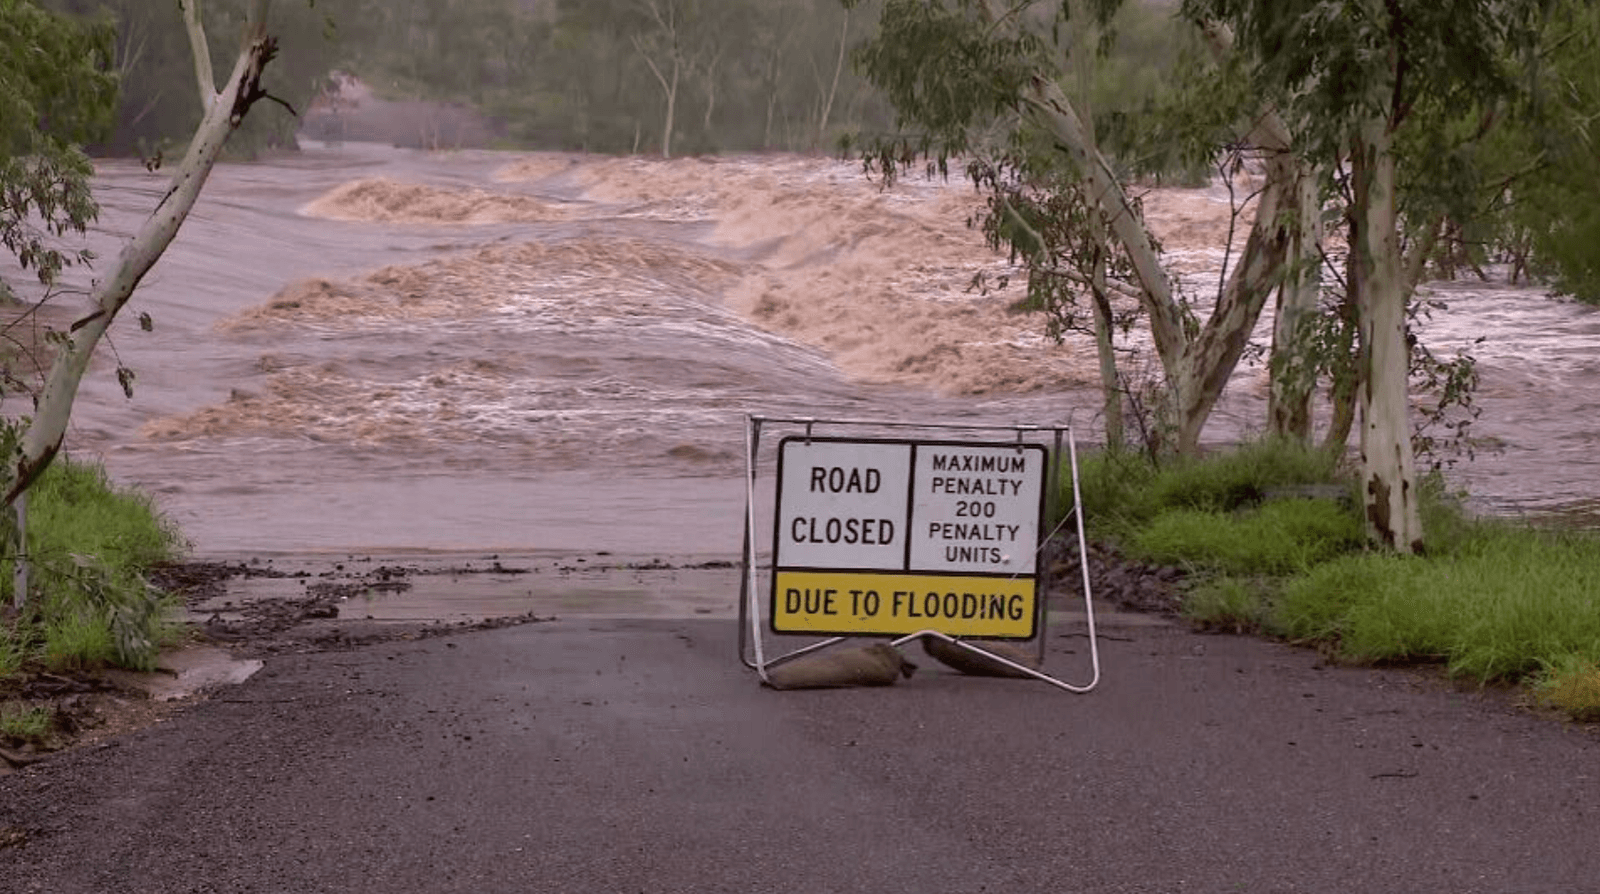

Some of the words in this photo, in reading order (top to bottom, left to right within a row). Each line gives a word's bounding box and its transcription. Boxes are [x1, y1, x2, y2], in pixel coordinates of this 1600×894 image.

[932, 454, 1025, 473] MAXIMUM
[810, 466, 881, 493] ROAD
[931, 477, 1023, 496] PENALTY
[956, 500, 995, 518] 200
[791, 517, 894, 545] CLOSED
[929, 523, 1020, 541] PENALTY
[945, 546, 1001, 564] UNITS
[785, 588, 838, 615] DUE
[849, 590, 880, 616] TO
[892, 591, 1024, 620] FLOODING
